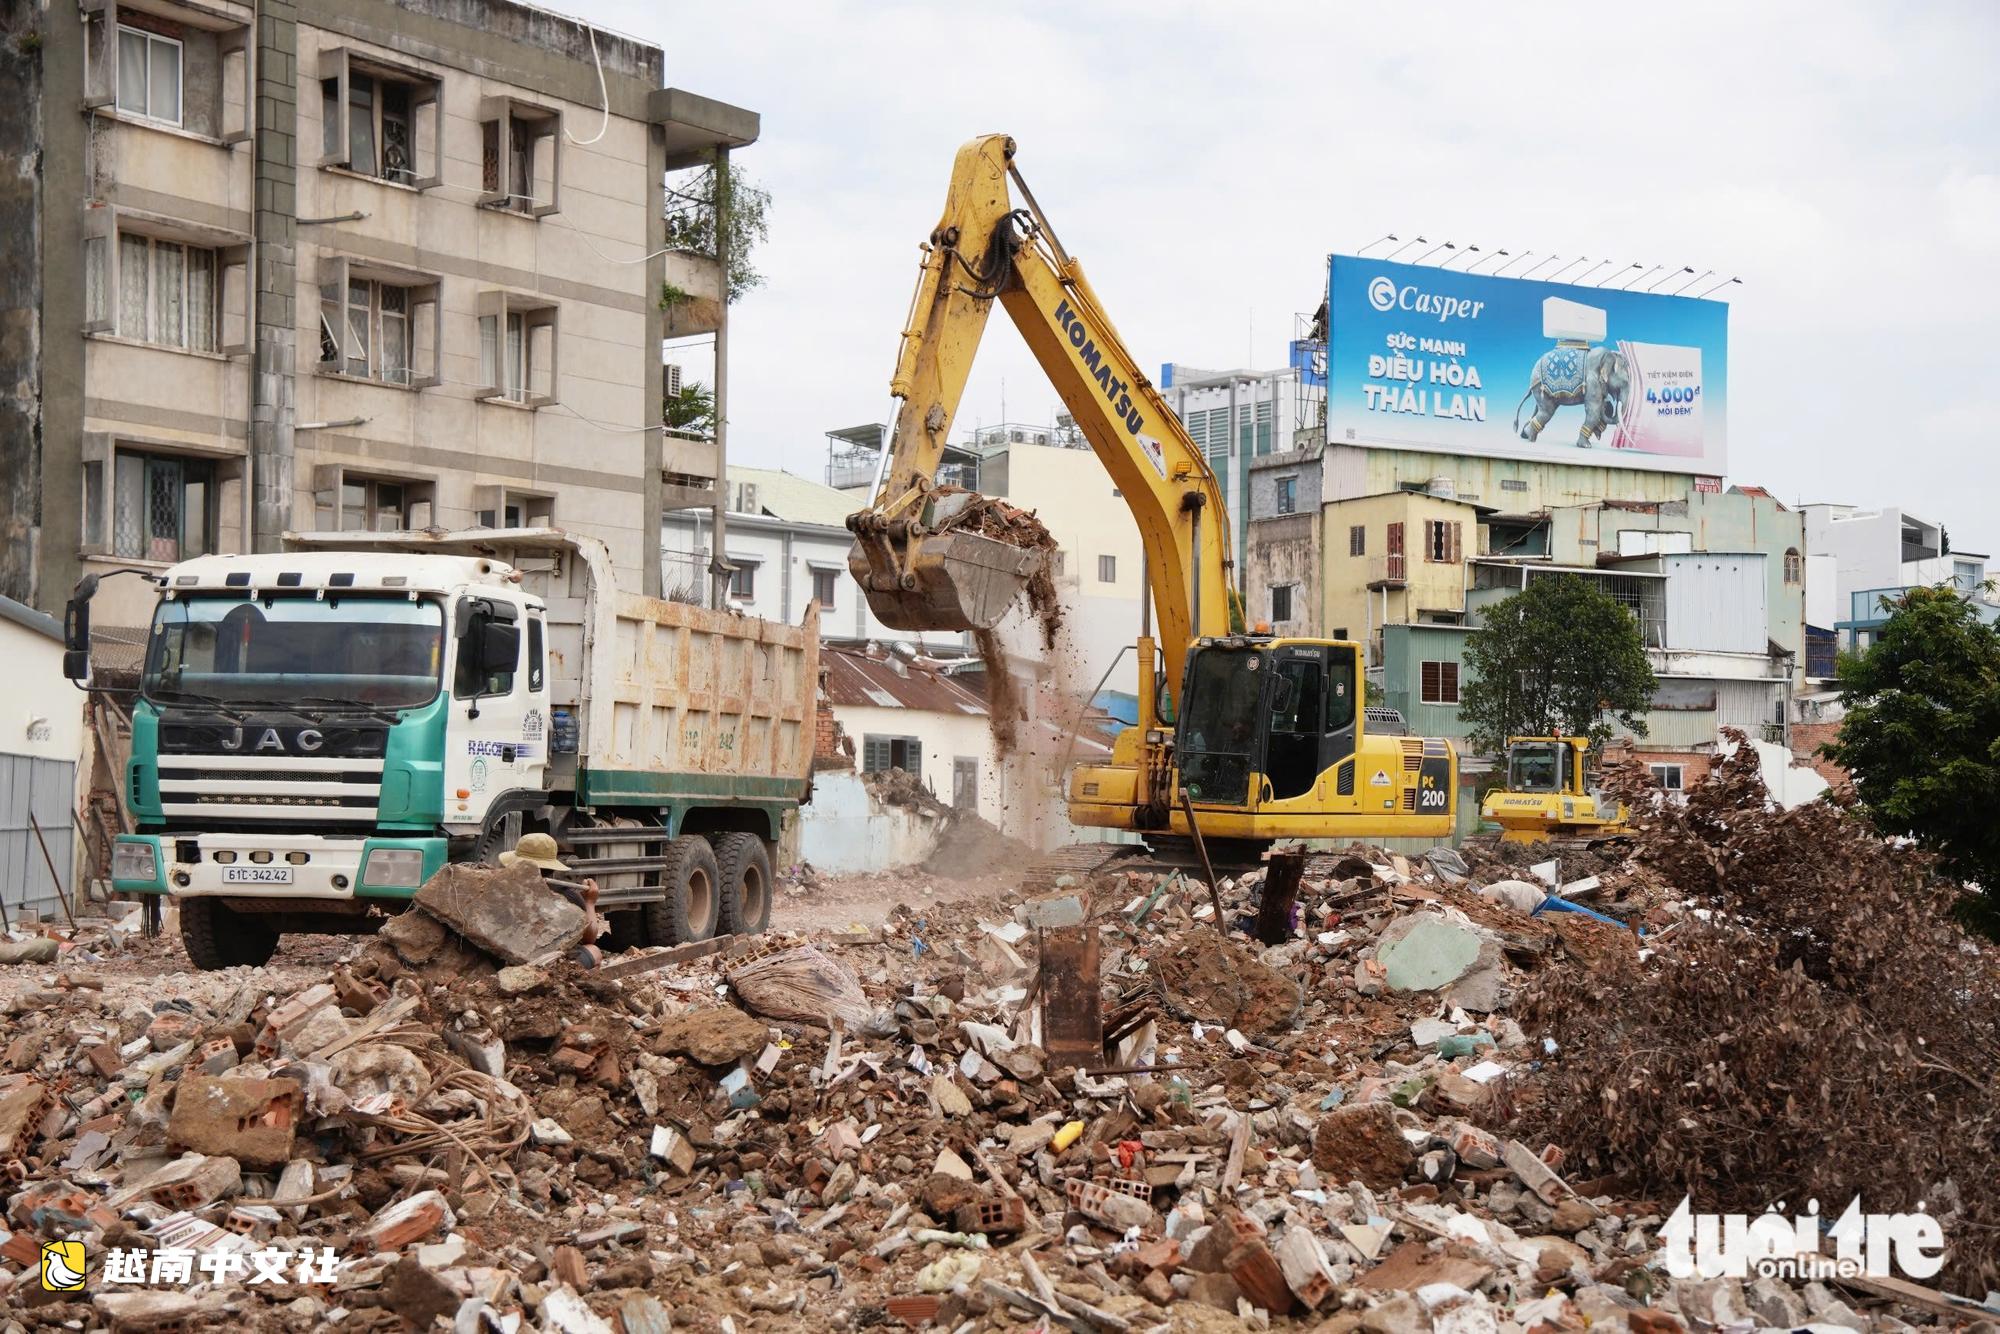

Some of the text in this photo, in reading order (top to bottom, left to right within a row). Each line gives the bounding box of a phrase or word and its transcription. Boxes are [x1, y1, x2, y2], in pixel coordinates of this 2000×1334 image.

[1398, 286, 1485, 323] Casper
[1386, 331, 1466, 357] SỨC MẠNH
[1054, 299, 1145, 436] KOMATSU
[1368, 348, 1482, 389] ĐIỀU HÒA
[1362, 382, 1487, 422] THÁI LAN
[222, 727, 324, 751] JAC
[1422, 775, 1435, 789] PC
[1421, 789, 1446, 807] 200
[1503, 798, 1543, 806] KOMATSU
